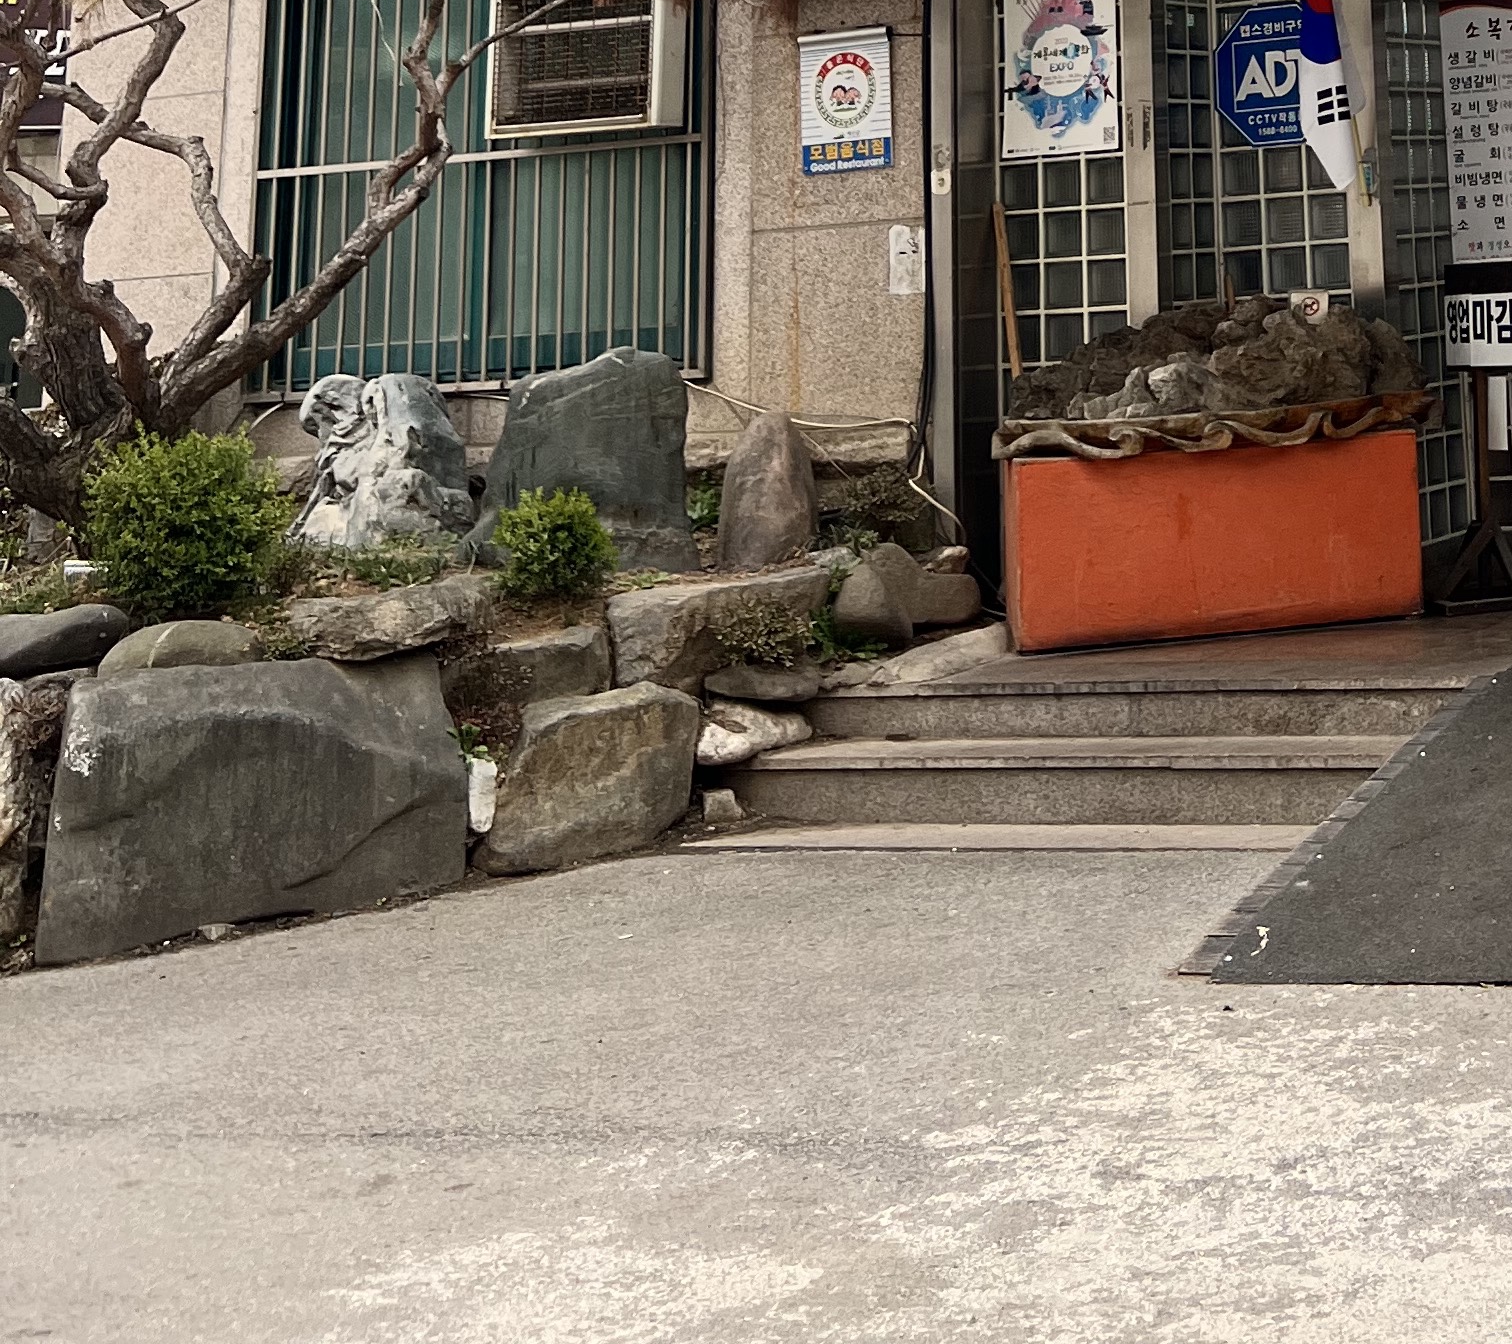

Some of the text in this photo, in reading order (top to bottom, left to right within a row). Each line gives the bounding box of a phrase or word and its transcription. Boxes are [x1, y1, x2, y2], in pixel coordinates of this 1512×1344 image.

[1450, 73, 1497, 90] 양념갈비
[810, 137, 884, 160] 모범음식점
[810, 157, 885, 172] Good Restaurant
[1455, 170, 1503, 187] 비빔냉면
